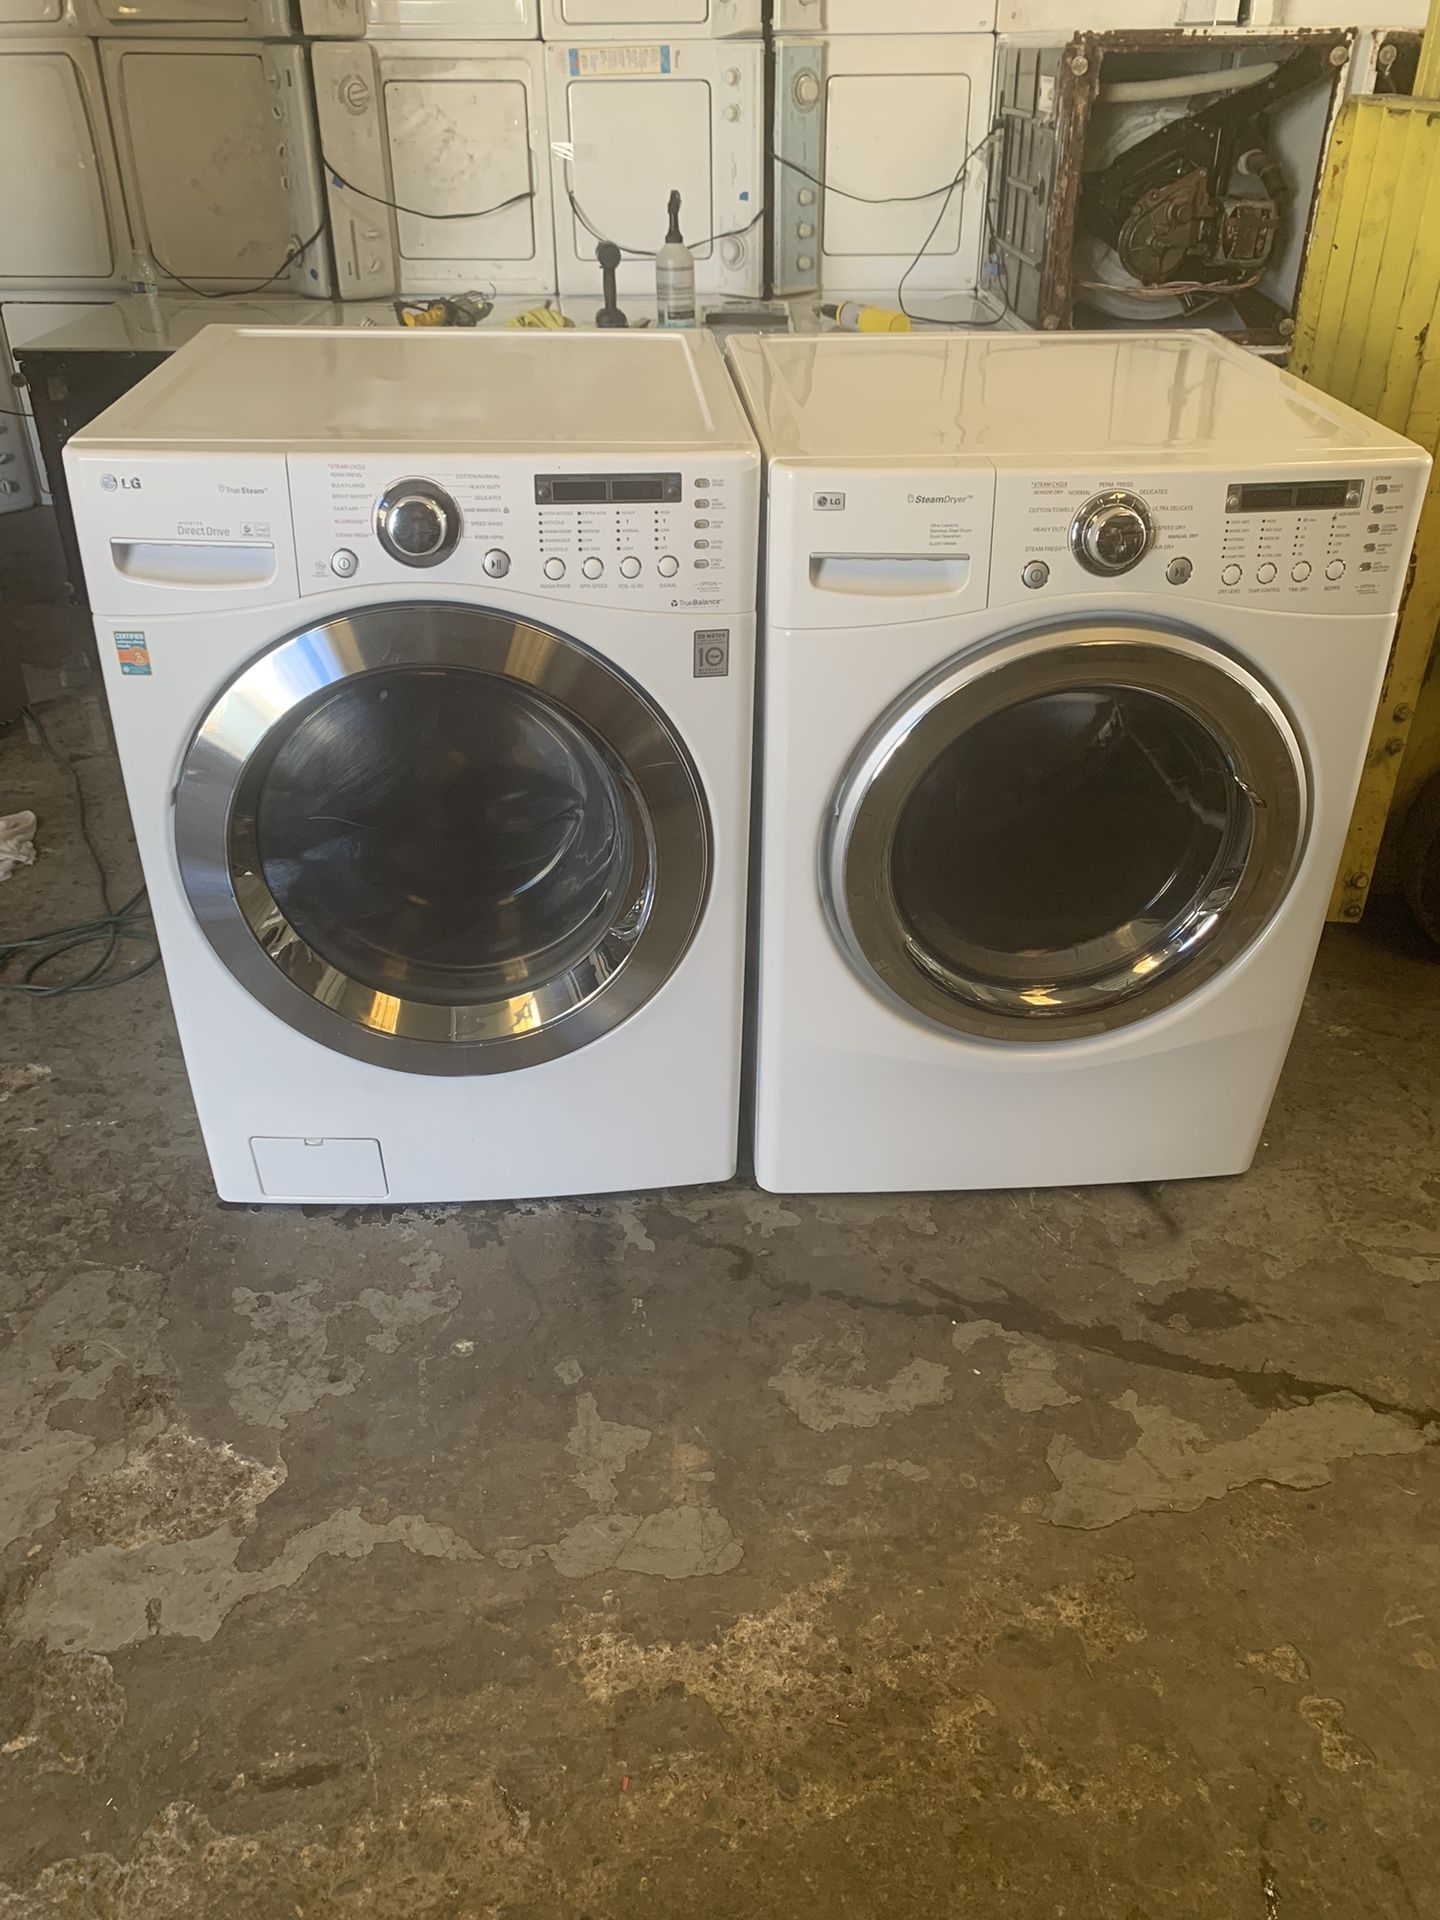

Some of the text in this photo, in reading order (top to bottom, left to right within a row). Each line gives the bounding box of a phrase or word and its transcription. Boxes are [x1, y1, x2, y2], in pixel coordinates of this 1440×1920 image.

[121, 477, 142, 490] LG
[1052, 480, 1068, 488] CYCLE
[829, 498, 841, 506] LG
[1170, 504, 1194, 512] DELICATE
